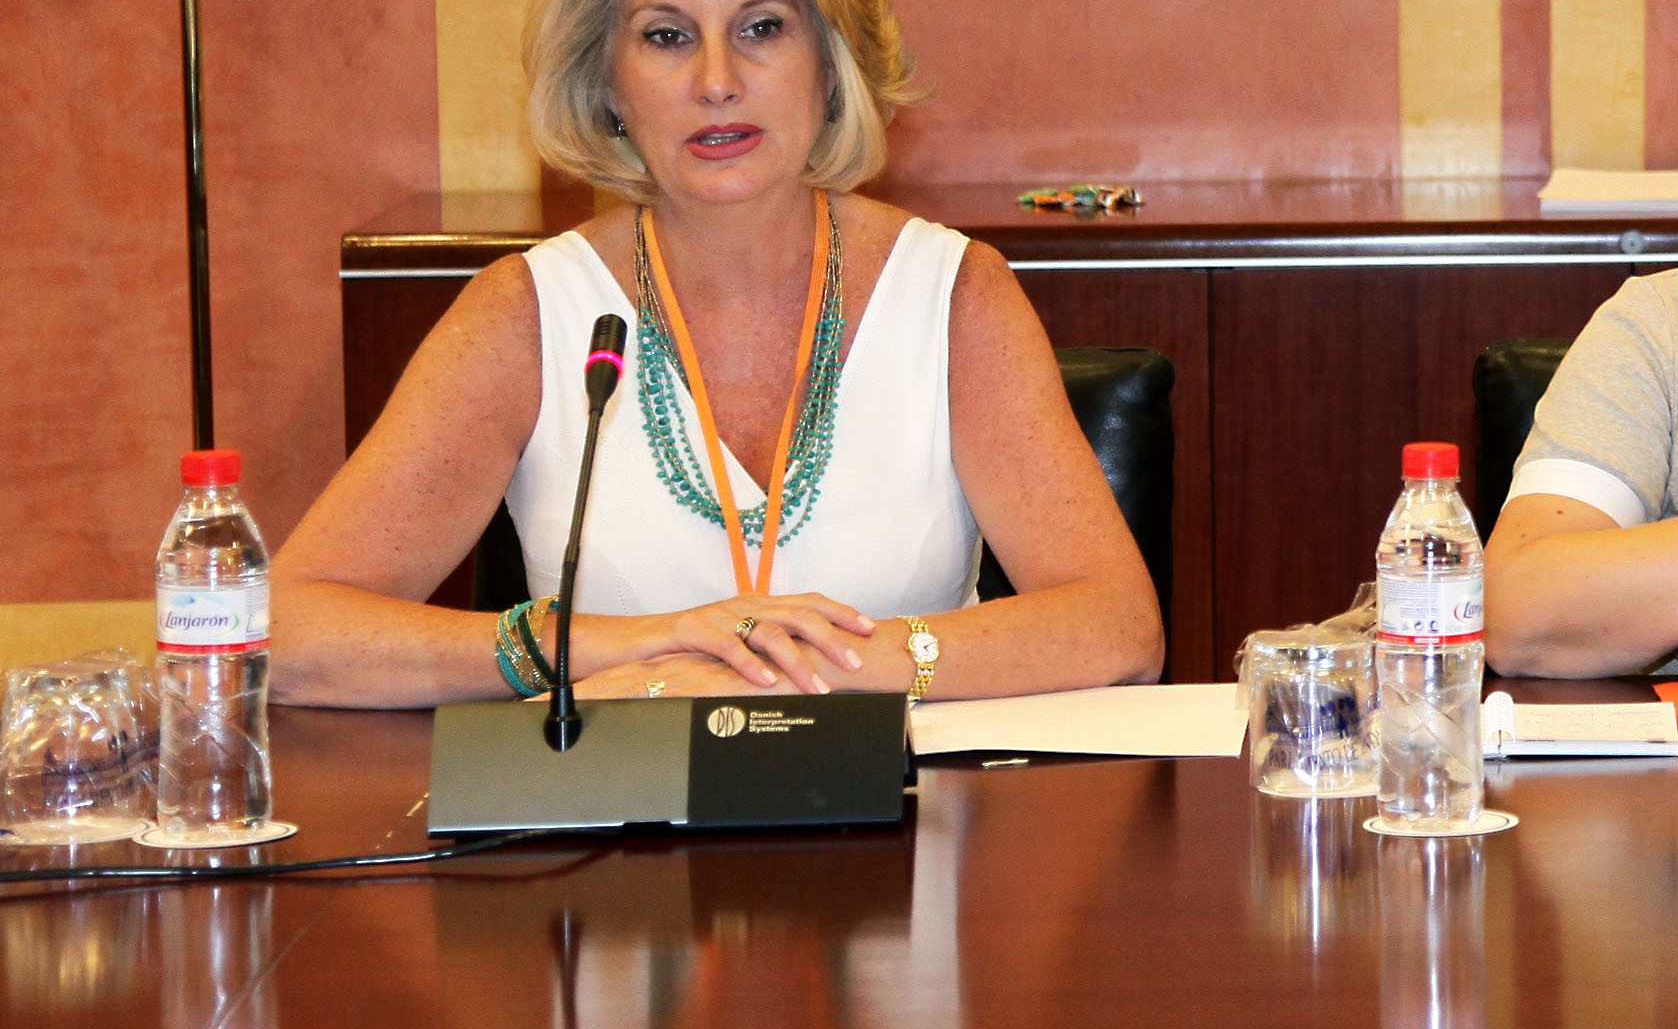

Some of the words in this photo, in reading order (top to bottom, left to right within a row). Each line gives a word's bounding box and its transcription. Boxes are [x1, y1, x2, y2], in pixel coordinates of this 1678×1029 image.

[165, 611, 229, 631] Lanjarón
[750, 711, 783, 719] Danish
[749, 718, 815, 726] Interpretation
[748, 725, 790, 733] Systems
